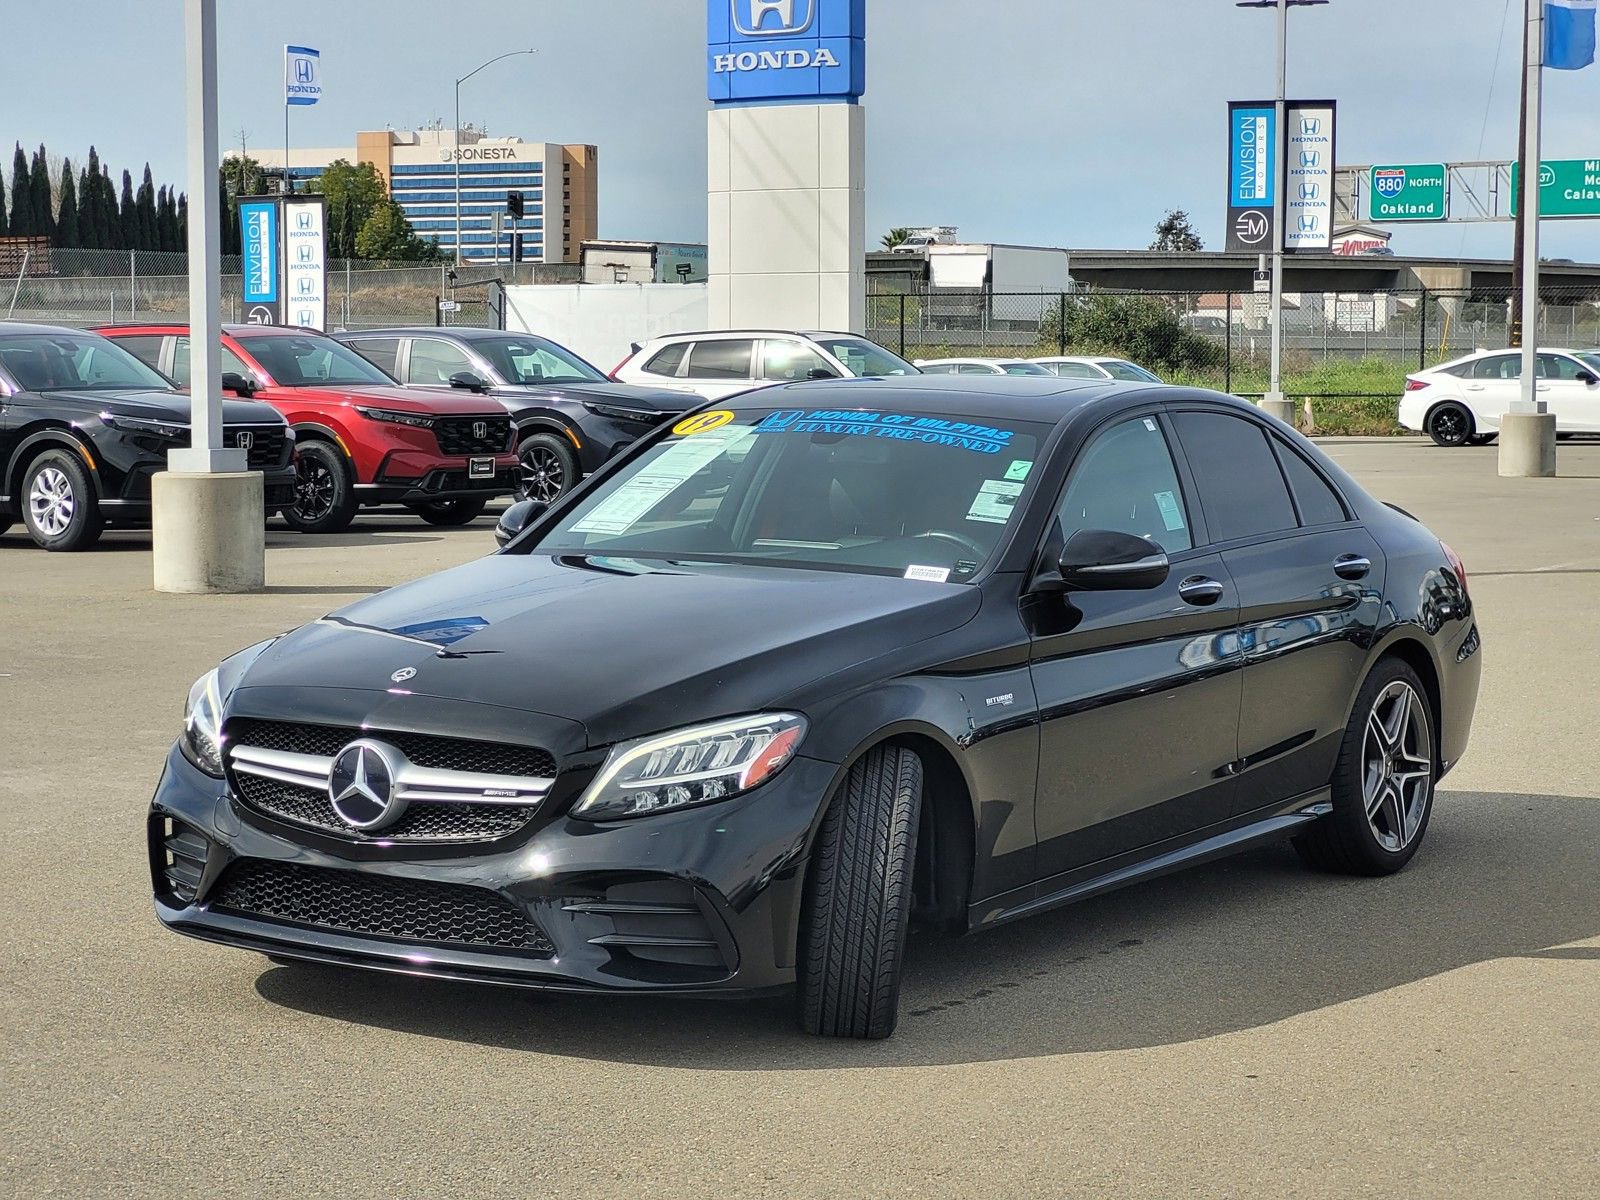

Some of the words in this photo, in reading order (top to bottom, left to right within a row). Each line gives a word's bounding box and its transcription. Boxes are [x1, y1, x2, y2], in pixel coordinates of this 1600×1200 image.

[713, 49, 839, 73] HONDA
[287, 85, 322, 94] HONDA
[454, 148, 517, 160] SONESTA
[1240, 116, 1255, 199] ENVISION
[1378, 179, 1402, 191] 880
[1409, 178, 1442, 188] NORTH
[1380, 202, 1434, 215] Oakland
[247, 211, 262, 294] ENVISION
[679, 414, 725, 432] 19
[806, 410, 880, 421] HONDA
[881, 414, 916, 424] OF
[912, 417, 1014, 440] MILPITAS
[792, 423, 877, 437] LUXURY
[875, 426, 1001, 454] PRE-OWNED
